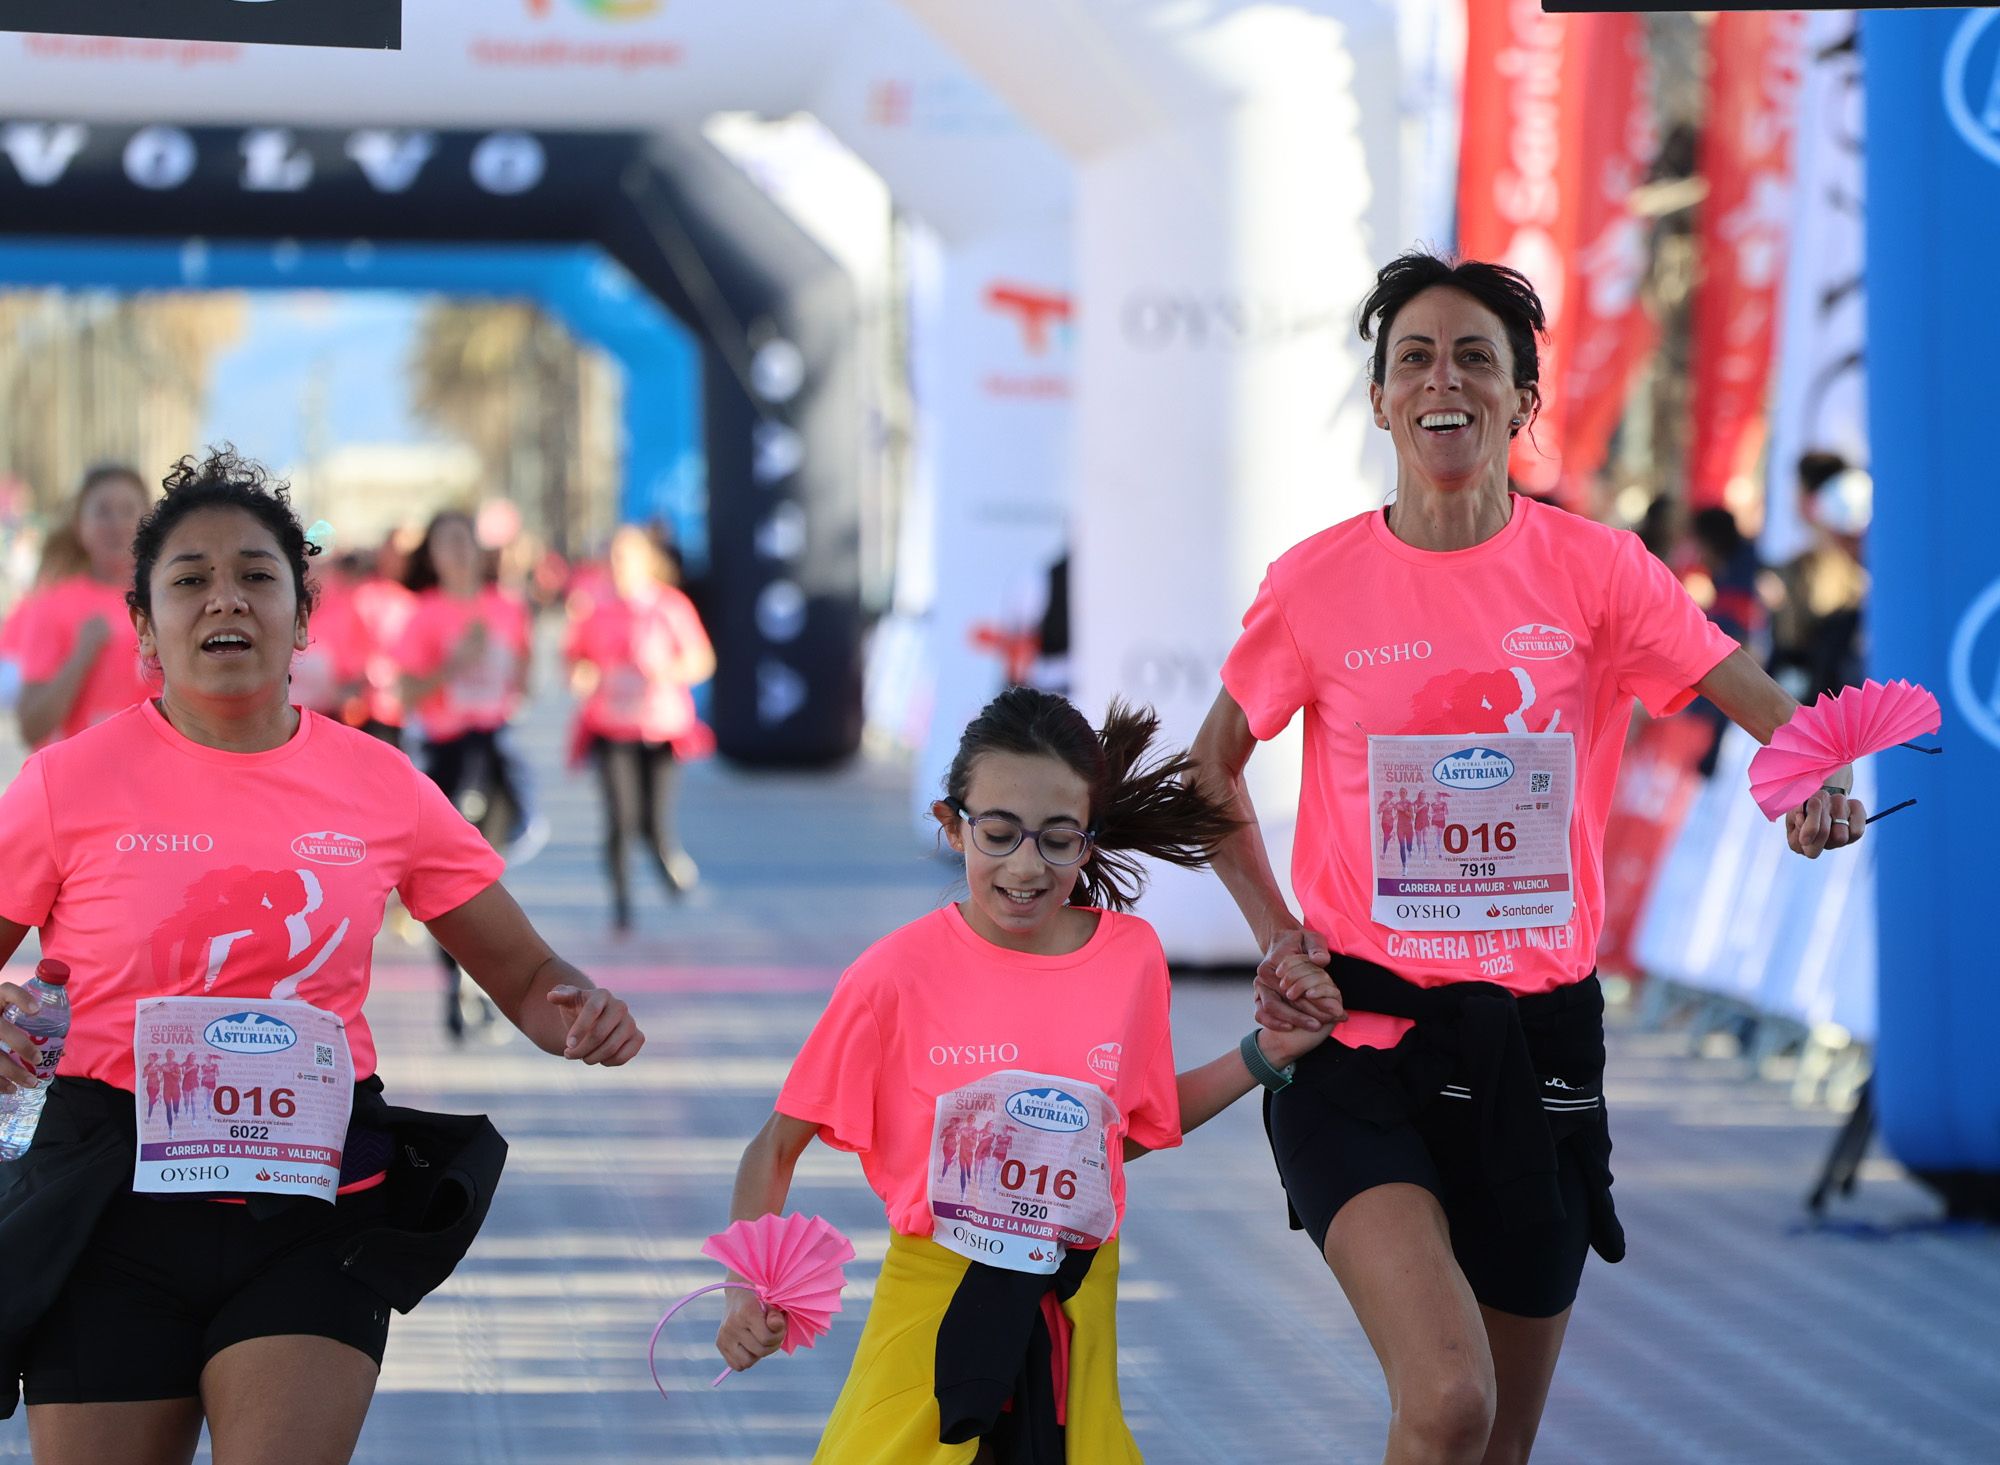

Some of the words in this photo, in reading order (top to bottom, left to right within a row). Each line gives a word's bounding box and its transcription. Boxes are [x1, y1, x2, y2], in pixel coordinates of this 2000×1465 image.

[1, 123, 547, 193] VOLVO
[1509, 637, 1569, 652] ASTURIANA
[1344, 640, 1432, 670] OYSHO
[1386, 772, 1424, 783] SUMA
[1440, 764, 1509, 780] ASTURIANA
[116, 833, 214, 852] OYSHO
[1443, 821, 1517, 854] 016
[298, 840, 361, 858] ASTURIANA
[1460, 863, 1496, 877] 7919
[1399, 883, 1441, 893] CARRERA
[1444, 883, 1456, 893] DE
[1459, 883, 1472, 893] LA
[1475, 882, 1505, 892] MUJER
[1513, 880, 1549, 891] VALENCIA
[1396, 904, 1460, 919] OYSHO
[1502, 903, 1553, 917] Santander
[1387, 933, 1470, 960] CARRERA
[1475, 931, 1498, 957] DE
[1503, 929, 1522, 949] LA
[1526, 926, 1574, 950] MUJER
[1480, 954, 1514, 977] 2025
[162, 1024, 194, 1033] DORSAL
[210, 1026, 290, 1045] ASTURIANA
[151, 1033, 194, 1045] SUMA
[929, 1042, 1019, 1066] OYSHO
[213, 1085, 296, 1118] 016
[955, 1099, 996, 1113] SUMA
[1011, 1098, 1084, 1127] ASTURIANA
[230, 1126, 269, 1140] 6022
[165, 1144, 210, 1157] CARRERA
[213, 1143, 226, 1153] DE
[229, 1144, 242, 1154] LA
[244, 1145, 278, 1157] MUJER
[288, 1148, 331, 1162] VALENCIA
[160, 1165, 229, 1182] OYSHO
[273, 1171, 331, 1188] Santander
[1000, 1159, 1077, 1200] 016
[1011, 1201, 1048, 1220] 7920
[953, 1226, 1004, 1255] OYSHO
[992, 1217, 1004, 1228] DE
[1007, 1219, 1018, 1231] LA
[1021, 1222, 1053, 1238] MUJER
[1057, 1230, 1085, 1245] VALENCIA
